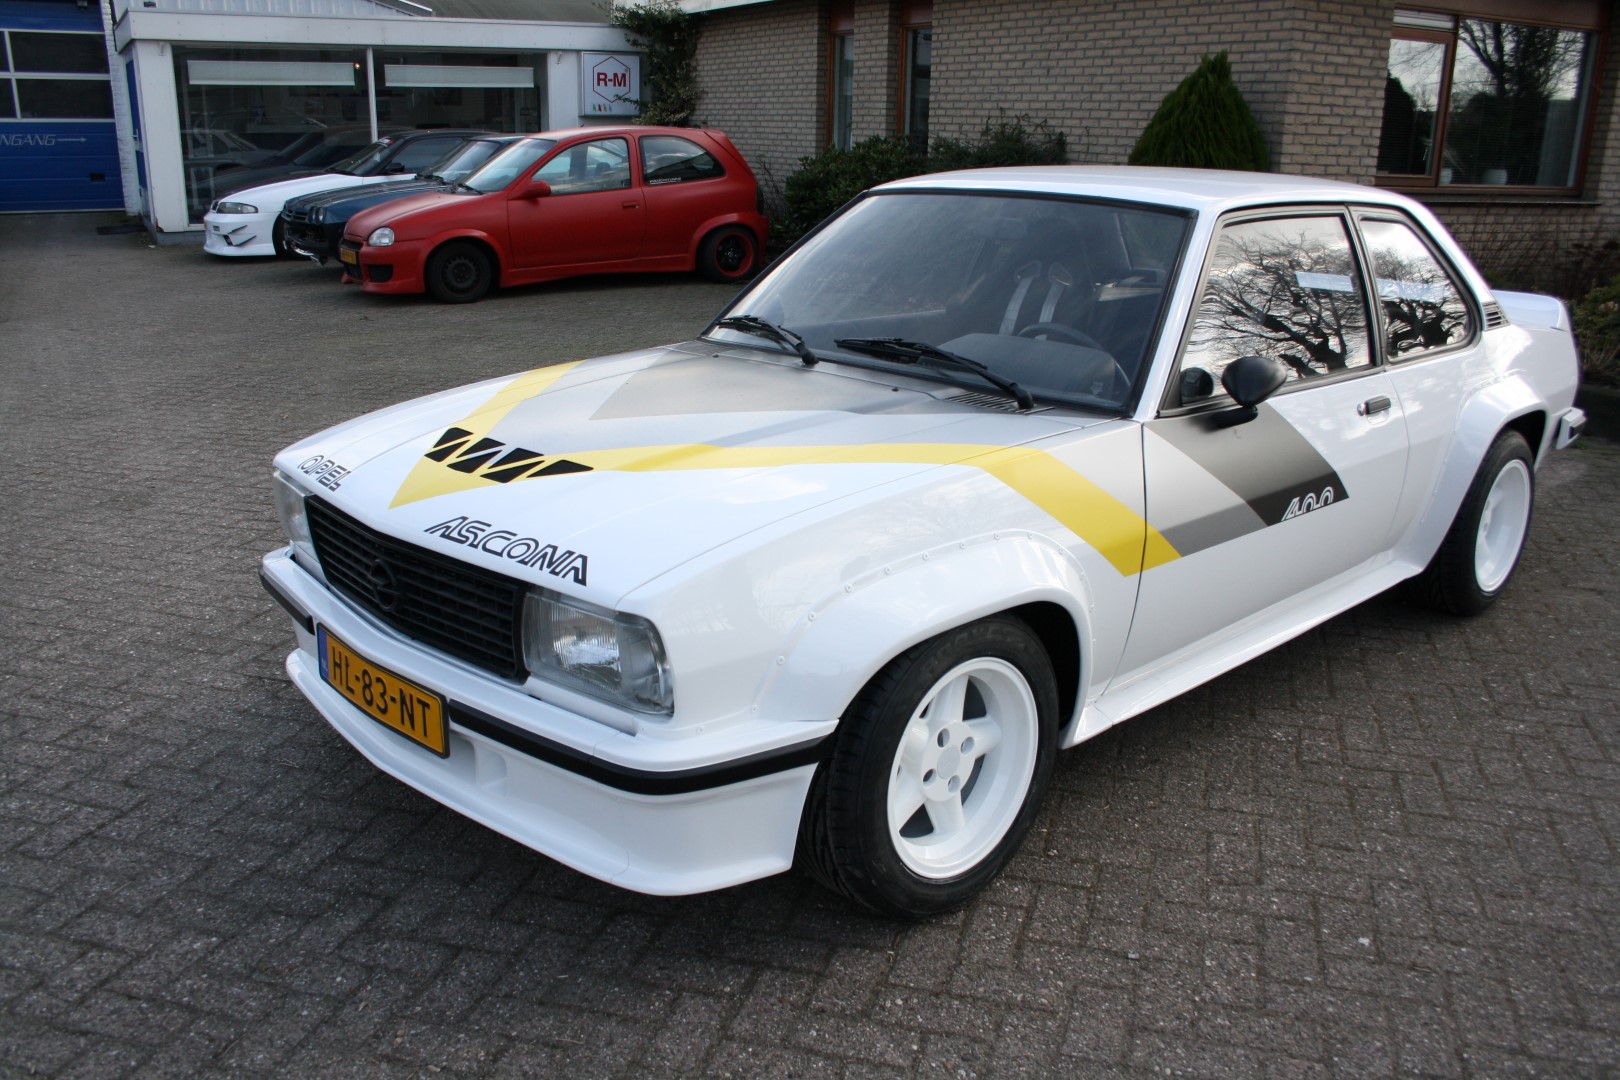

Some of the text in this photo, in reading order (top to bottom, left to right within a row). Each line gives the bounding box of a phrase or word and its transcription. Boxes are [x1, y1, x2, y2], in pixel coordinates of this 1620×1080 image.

[596, 71, 627, 88] R-M
[297, 455, 351, 492] OPEL
[1280, 486, 1335, 522] 400
[424, 516, 589, 587] ASCONA
[332, 646, 431, 738] HL-83-NT
